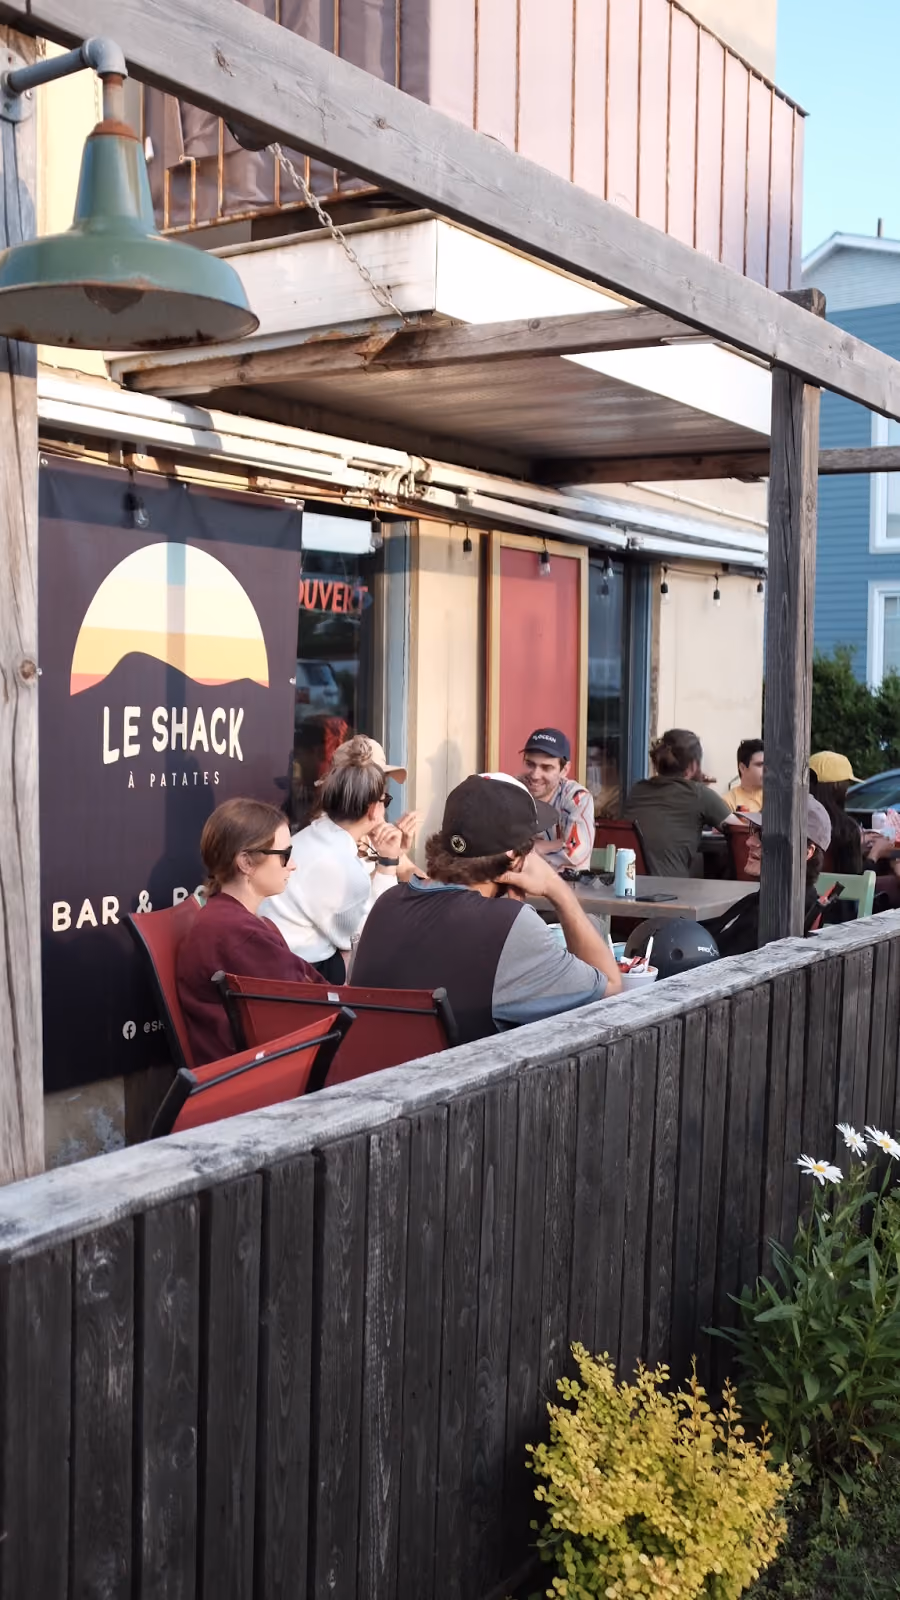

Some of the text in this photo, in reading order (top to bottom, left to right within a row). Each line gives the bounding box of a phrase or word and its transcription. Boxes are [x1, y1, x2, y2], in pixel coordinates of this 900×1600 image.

[103, 706, 244, 764] LE SHACK
[127, 771, 220, 788] À PATATES
[52, 895, 120, 932] BAR
[136, 890, 153, 913] &
